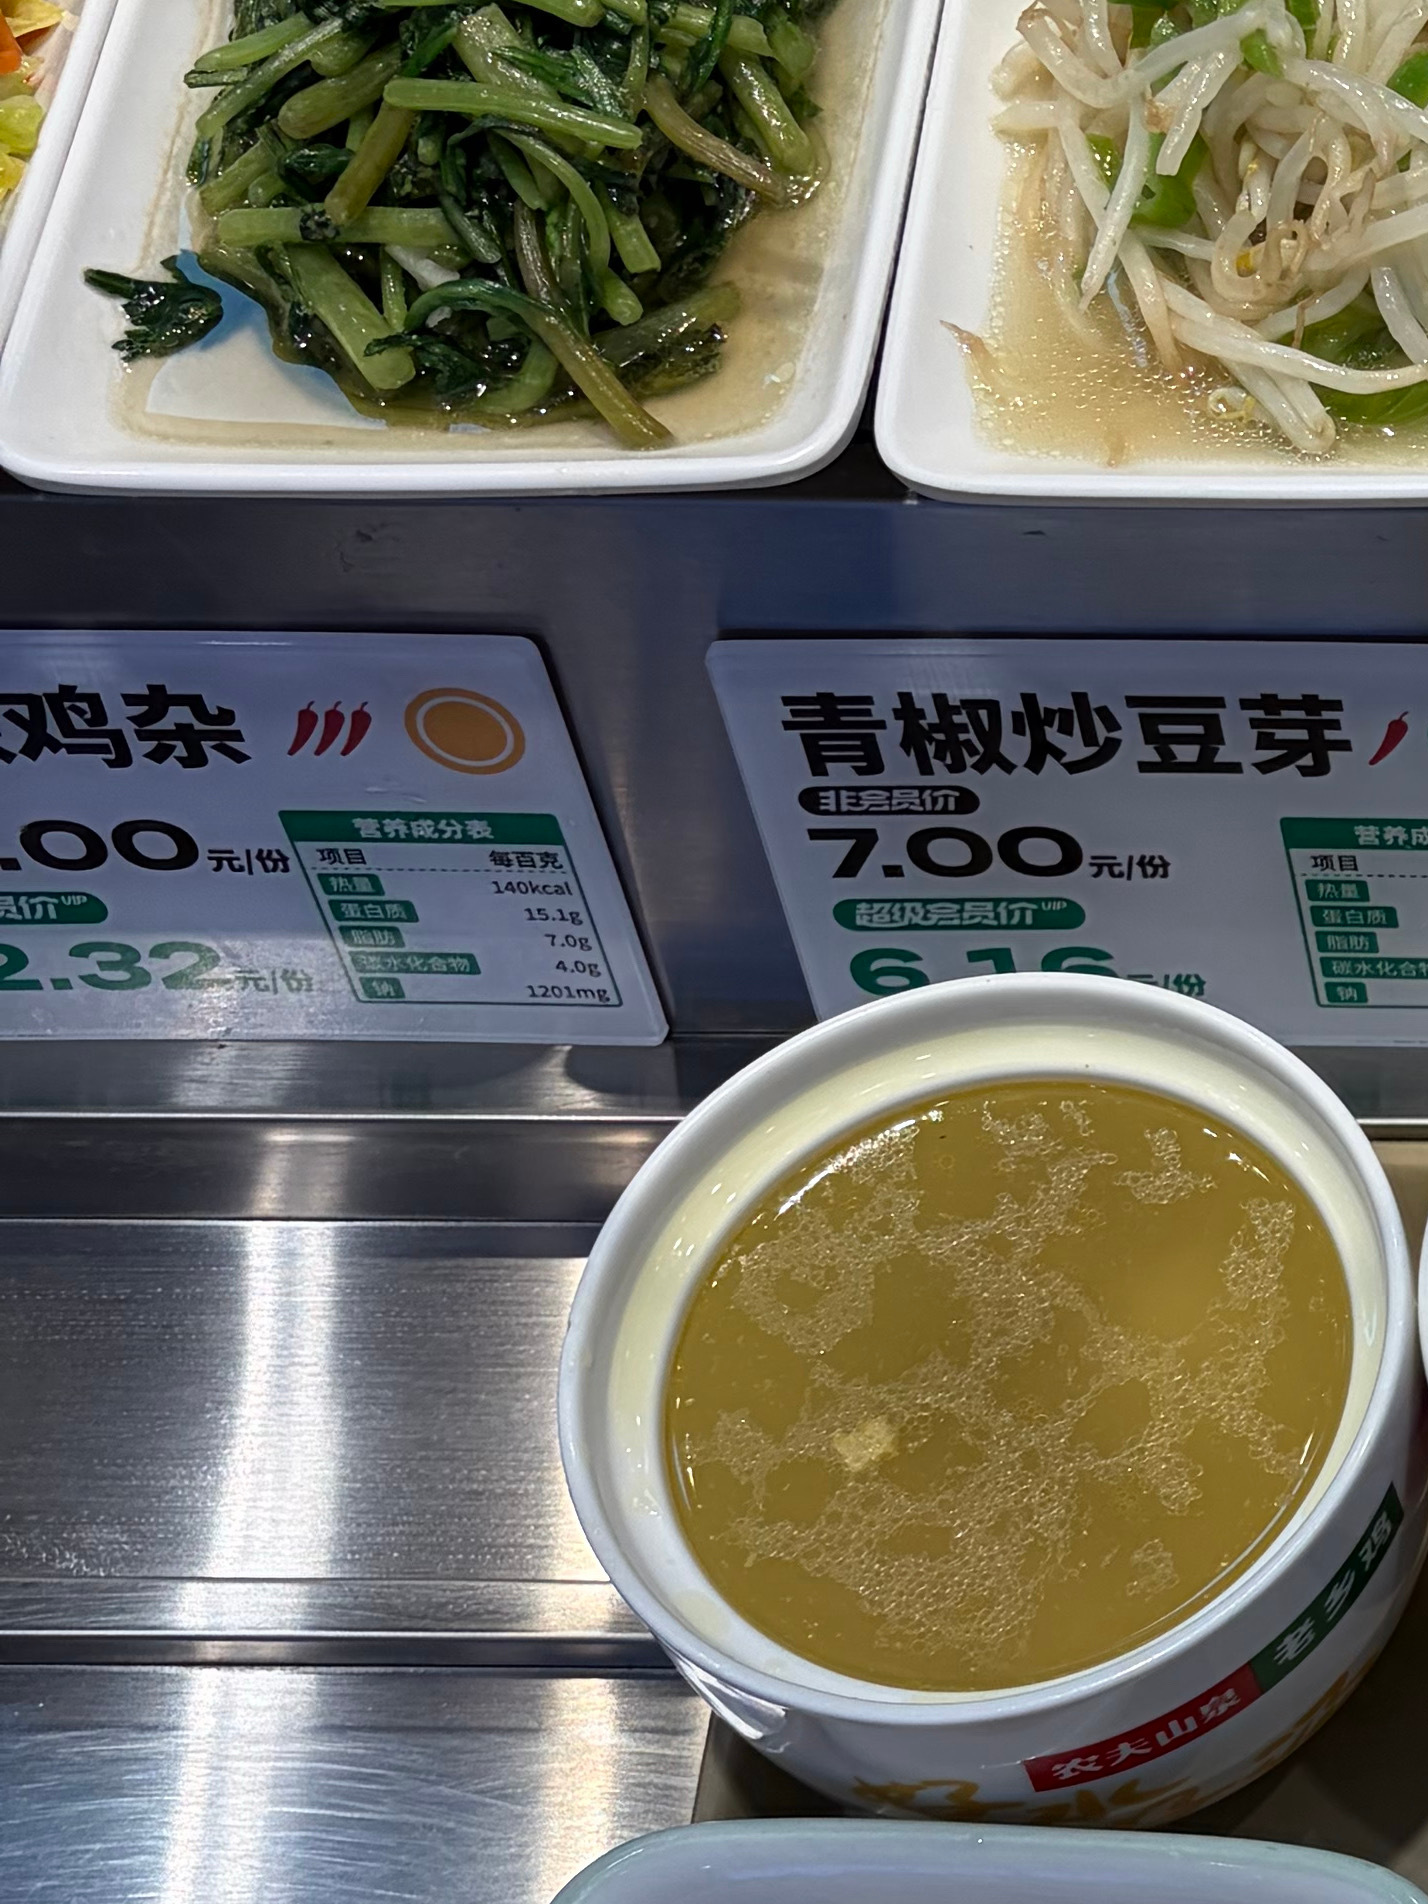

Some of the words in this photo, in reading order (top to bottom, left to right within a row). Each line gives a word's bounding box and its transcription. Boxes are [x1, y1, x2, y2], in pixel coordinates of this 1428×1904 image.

[0, 684, 252, 768] 鸡杂
[781, 691, 1353, 778] 青椒炒豆芽
[819, 789, 961, 813] 非会员价
[352, 816, 495, 841] 营养成分表
[316, 847, 367, 867] 项目
[488, 850, 564, 871] 每百克
[1311, 853, 1359, 872] 项目
[492, 880, 572, 897] 140kcal
[524, 906, 583, 926] 15.1g
[544, 933, 592, 953] 7.0g
[555, 959, 601, 979] 4.0g
[525, 984, 610, 1003] 1201mg
[1051, 1686, 1242, 1782] 农夫山泉
[1273, 1509, 1393, 1667] 老乡鸡
